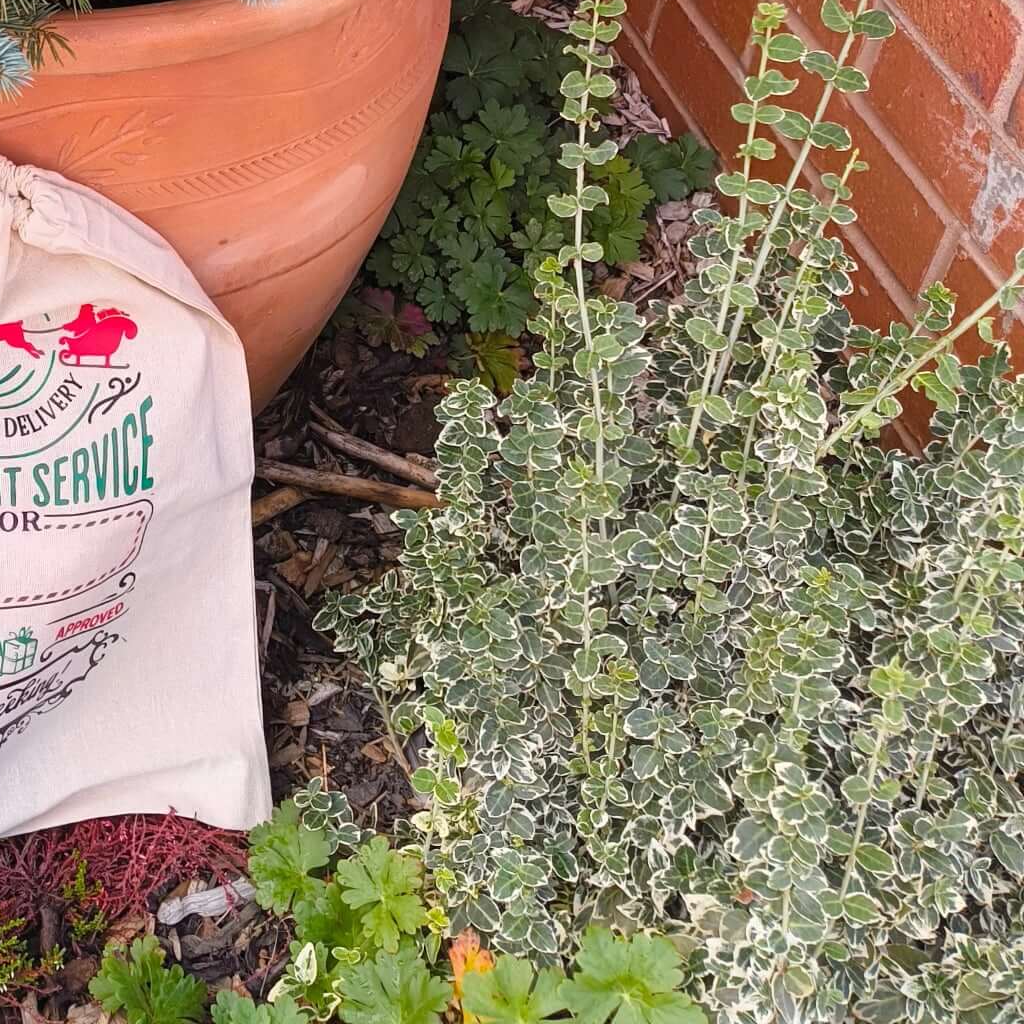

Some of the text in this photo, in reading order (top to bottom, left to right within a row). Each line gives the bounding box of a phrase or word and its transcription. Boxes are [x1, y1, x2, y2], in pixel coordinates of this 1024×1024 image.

[4, 372, 83, 438] DELIVERY
[32, 395, 154, 507] SERVICE
[55, 601, 125, 640] APPROVED
